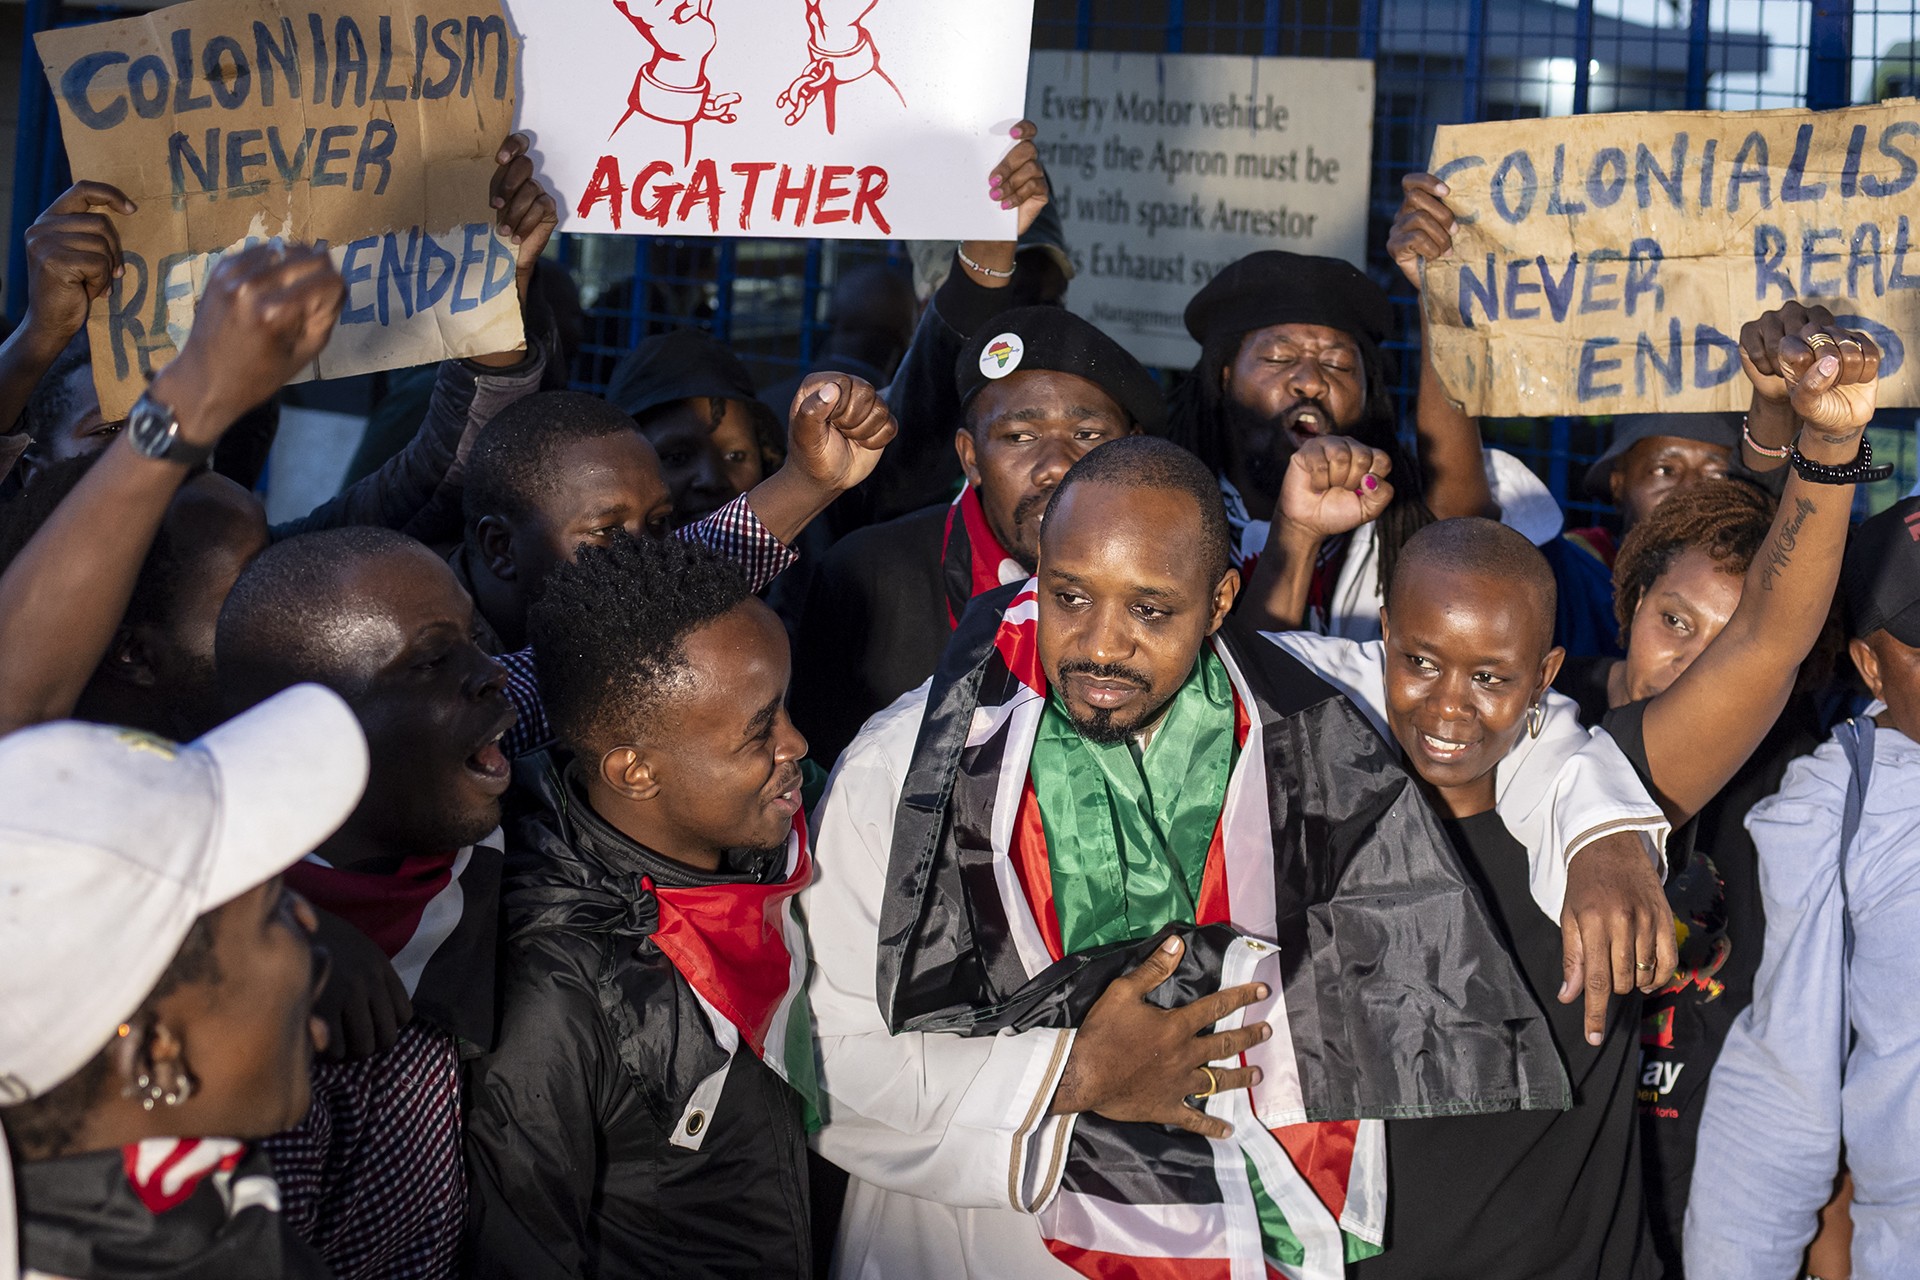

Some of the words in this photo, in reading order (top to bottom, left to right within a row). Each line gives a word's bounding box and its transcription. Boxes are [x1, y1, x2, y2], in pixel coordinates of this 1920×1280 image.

[60, 13, 509, 130] COLONIALISM
[1041, 85, 1108, 133] Every
[1113, 92, 1195, 129] Motor
[1200, 93, 1290, 132] vehicle
[168, 119, 398, 209] NEVER
[577, 155, 891, 235] AGATHER
[1036, 132, 1097, 181] ering
[1102, 134, 1144, 172] the
[1148, 138, 1227, 185] Apron
[1234, 152, 1298, 182] must
[1305, 145, 1340, 185] be
[1076, 187, 1130, 224] with
[1136, 192, 1206, 239] spark
[1209, 198, 1319, 239] Arrestor
[339, 222, 516, 327] ENDED
[1089, 241, 1186, 286] Exhaust
[1458, 237, 1666, 329] NEVER
[1754, 215, 1920, 301] REAL
[1578, 315, 1905, 403] ENDD
